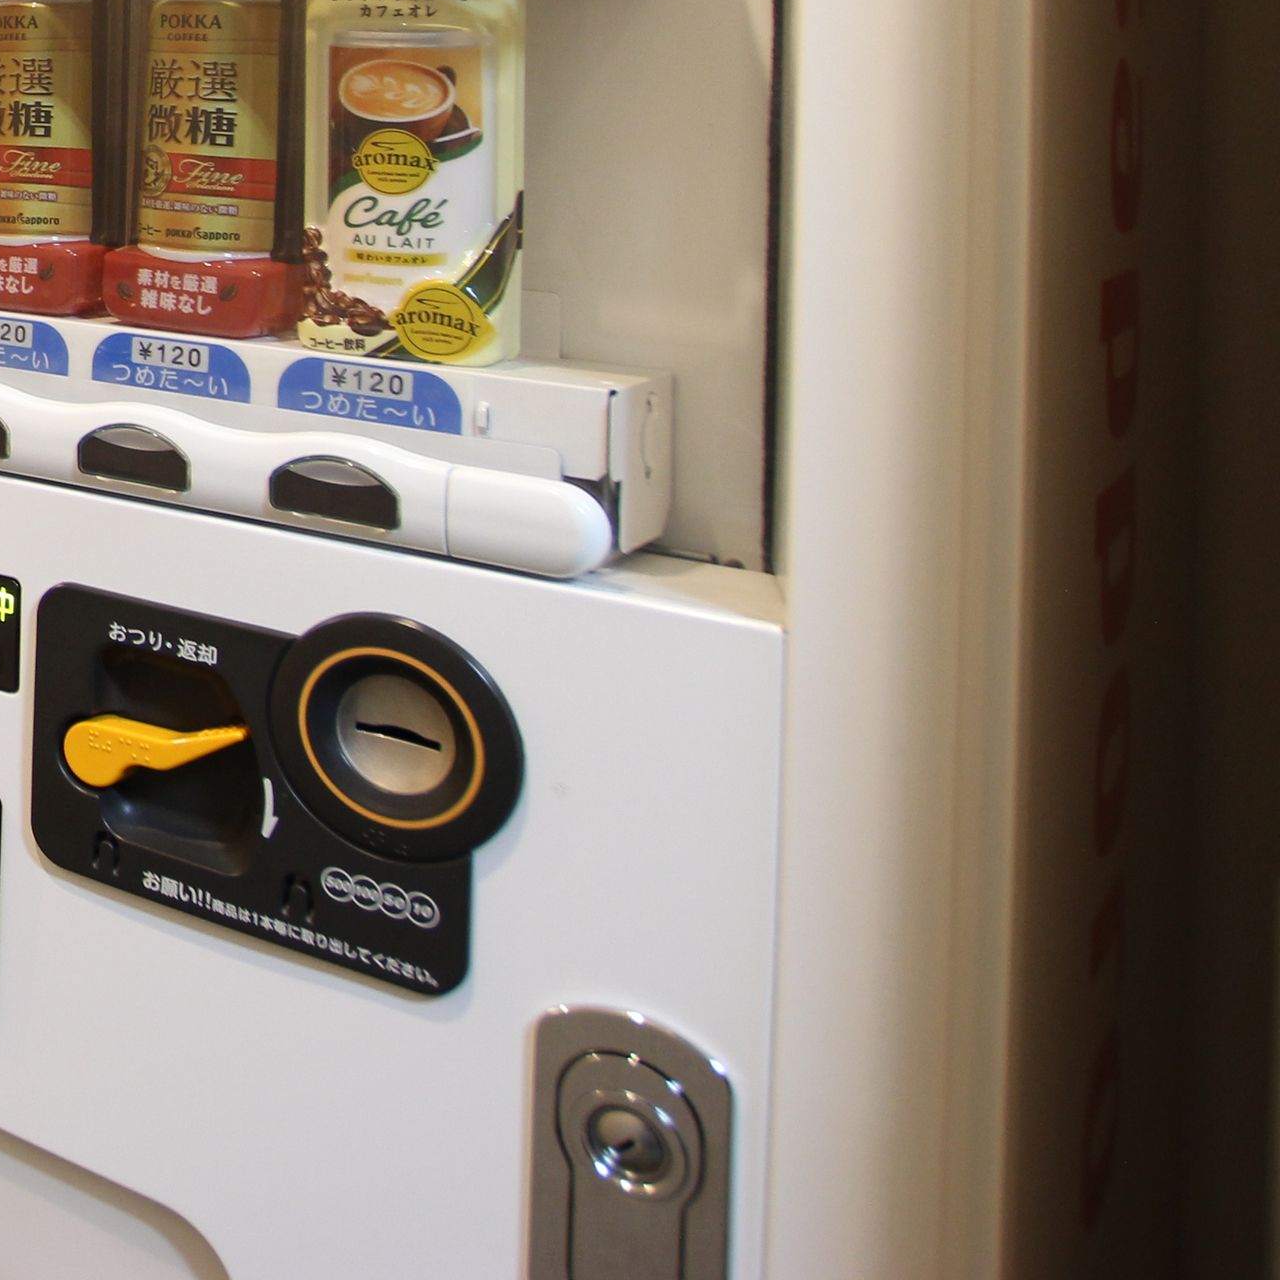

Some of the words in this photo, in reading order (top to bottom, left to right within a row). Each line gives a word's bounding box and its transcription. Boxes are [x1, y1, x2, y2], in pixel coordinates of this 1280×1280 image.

[160, 13, 223, 30] POKKA
[360, 5, 438, 18] カフェオレ
[150, 59, 238, 104] 厳選
[148, 104, 238, 147] 微糖
[0, 149, 61, 173] Fine
[173, 159, 244, 184] Fine
[353, 150, 438, 172] aromax
[344, 196, 448, 236] Café
[352, 234, 376, 245] AU
[387, 236, 435, 248] LAIT
[137, 268, 218, 294] 素材を厳選
[140, 291, 212, 315] 雑味なし
[395, 308, 480, 337] aromax
[138, 343, 202, 368] ¥120
[310, 337, 366, 351] コーヒー飲料
[331, 366, 406, 396] ¥120
[108, 621, 217, 666] おつり・返却
[327, 876, 351, 893] 500
[357, 885, 380, 901] 100
[384, 893, 405, 908] 50
[414, 904, 432, 919] 10
